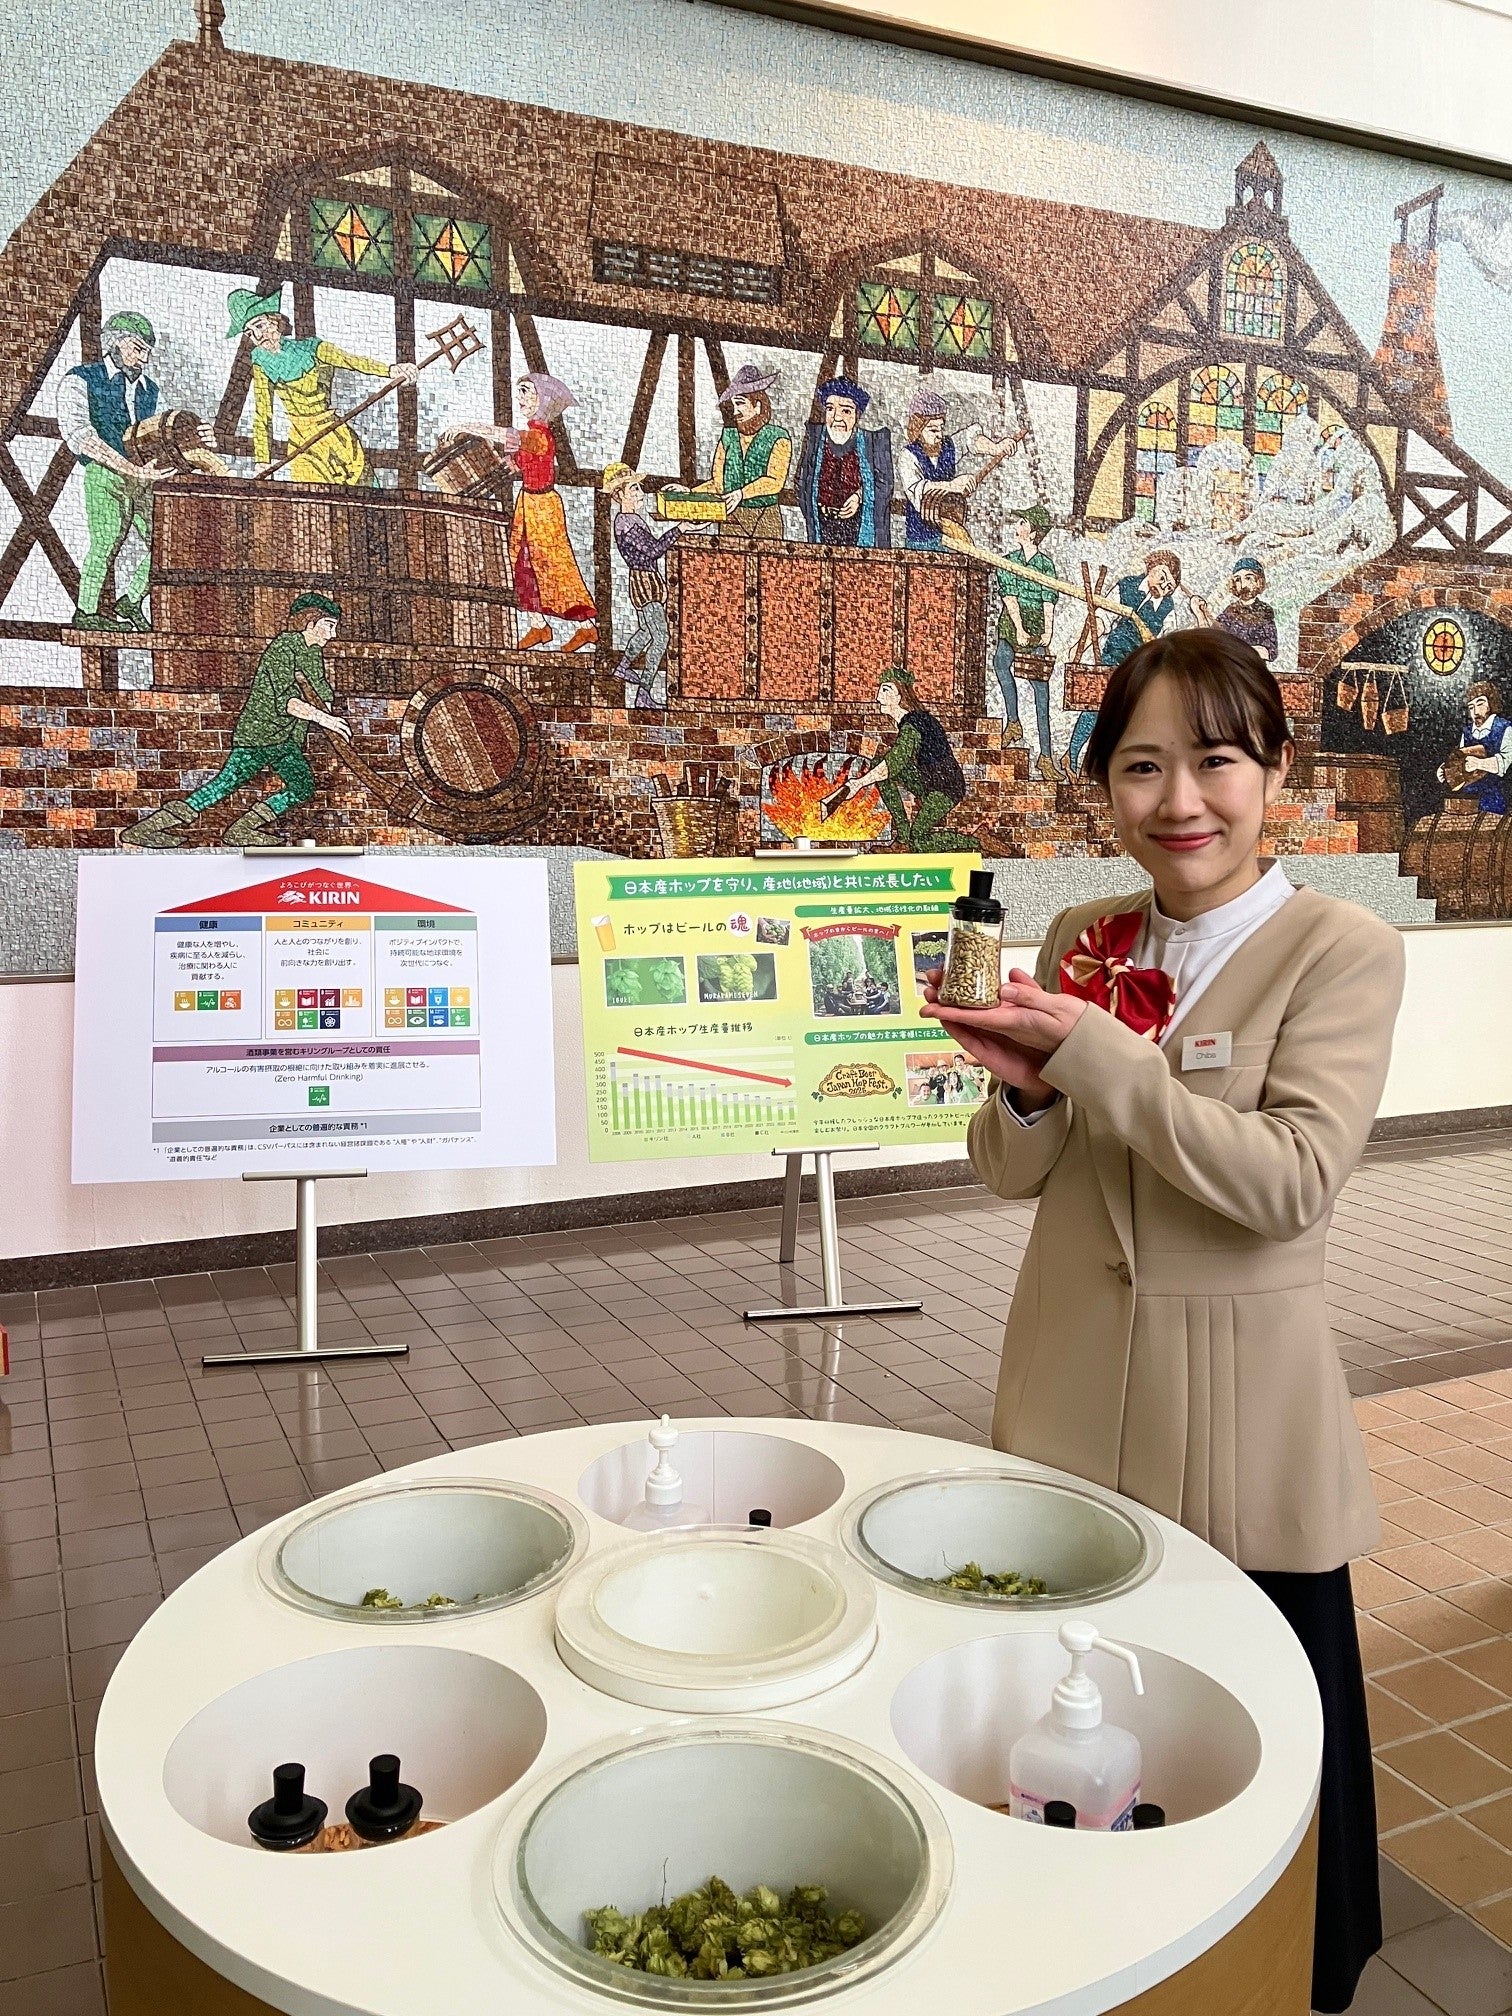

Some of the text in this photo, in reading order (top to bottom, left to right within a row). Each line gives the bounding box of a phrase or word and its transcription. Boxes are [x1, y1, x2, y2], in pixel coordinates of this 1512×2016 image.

[279, 881, 360, 889] よろこびがつなぐ世界へ
[624, 872, 940, 895] 日本産ホップを守り、産地(地域)と共に成長したい
[309, 891, 360, 905] KIRIN
[199, 920, 218, 929] 健康
[293, 919, 344, 928] コミュニティ
[417, 919, 436, 928] 環境
[623, 914, 750, 936] ホップはビールの魂
[307, 948, 330, 956] 社会に
[634, 1022, 753, 1037] 日本産ホップ生産量推移
[1195, 1039, 1216, 1047] KIRIN
[274, 1072, 363, 1083] (Zero Harmful Drinking)
[835, 1069, 857, 1080] Craft
[826, 1077, 888, 1092] Japan Hop Fest.
